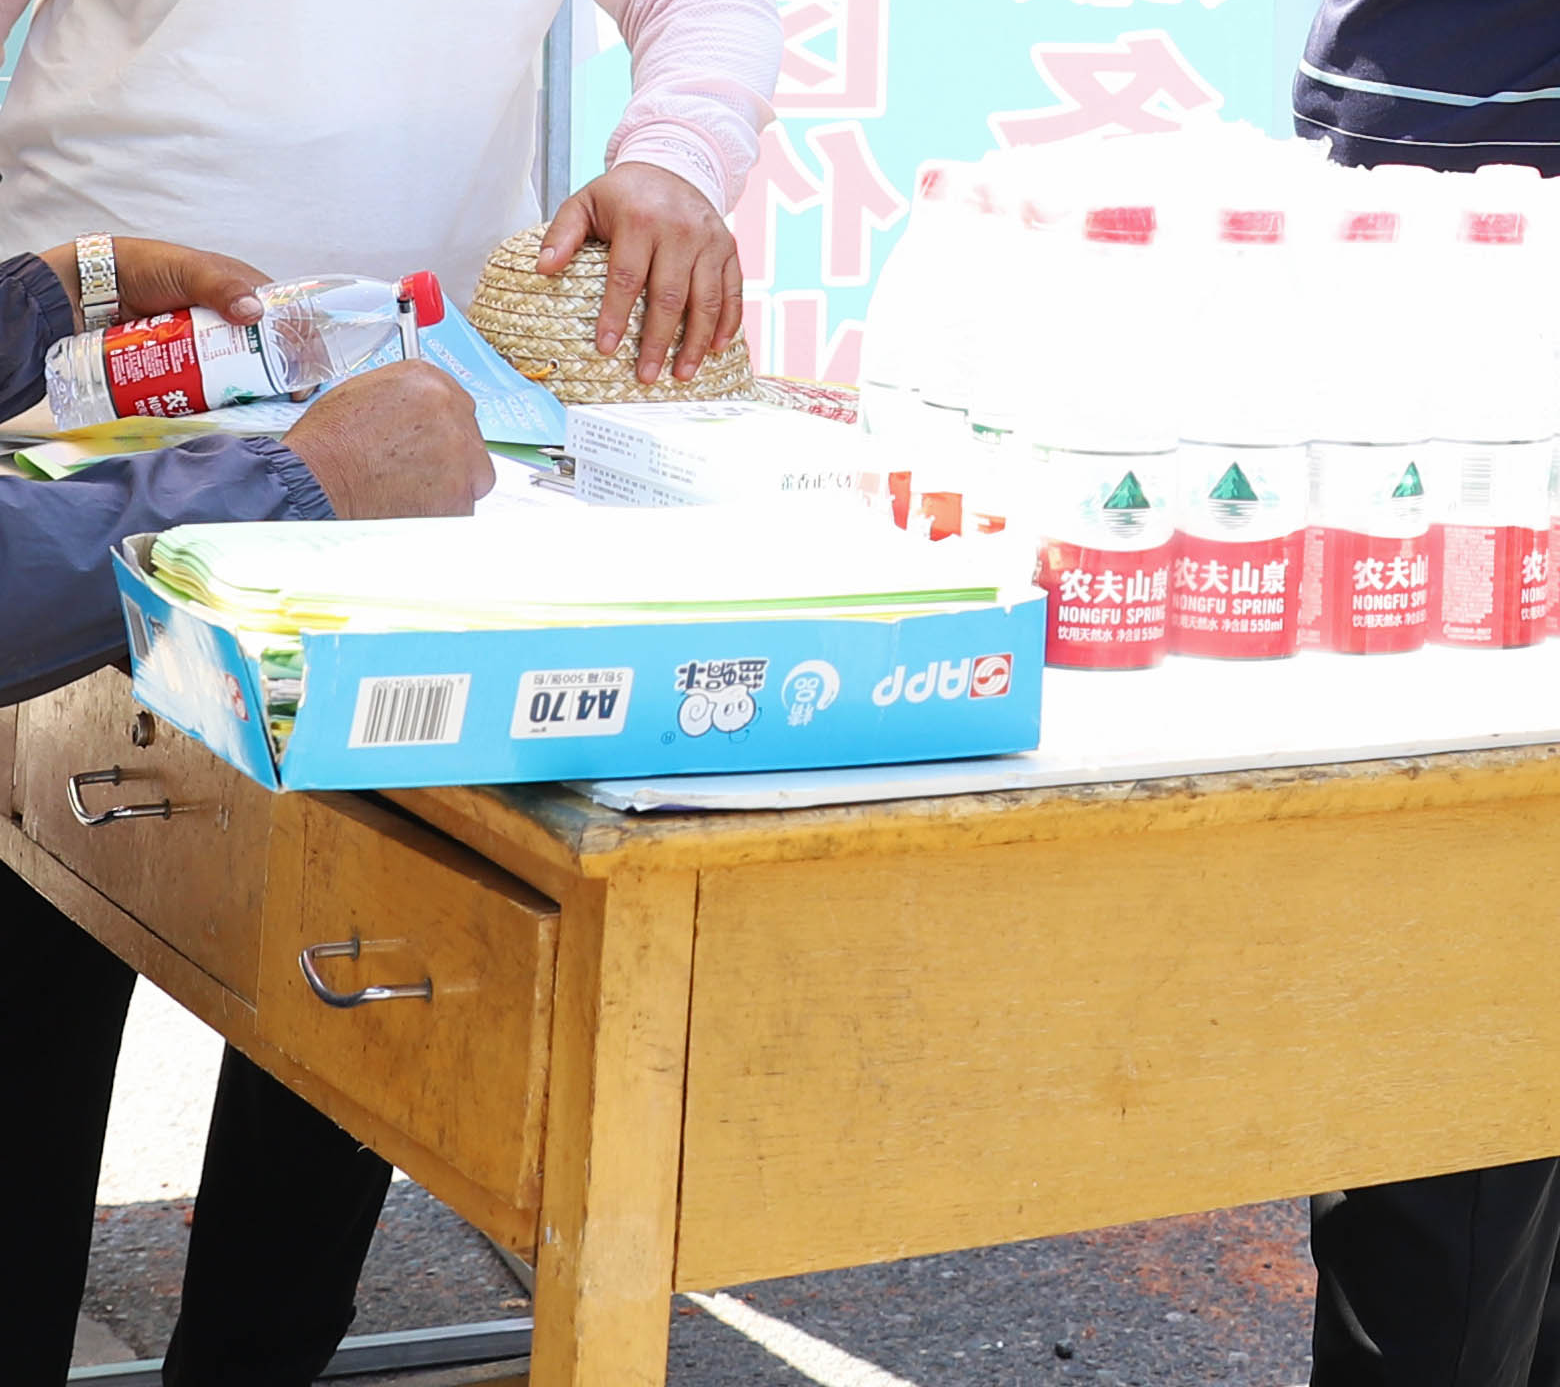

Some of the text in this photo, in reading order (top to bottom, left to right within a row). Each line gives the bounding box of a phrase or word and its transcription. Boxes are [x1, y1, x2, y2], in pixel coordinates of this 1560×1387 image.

[1060, 569, 1168, 604] 农夫山泉
[1175, 557, 1288, 595] 农夫山泉
[1232, 597, 1284, 615] SPRING
[1353, 590, 1408, 611] NONGFU
[1059, 605, 1121, 625] NONGFU
[1057, 626, 1113, 643] 饮用天然水
[872, 660, 971, 708] APP
[529, 688, 619, 725] A4 70
